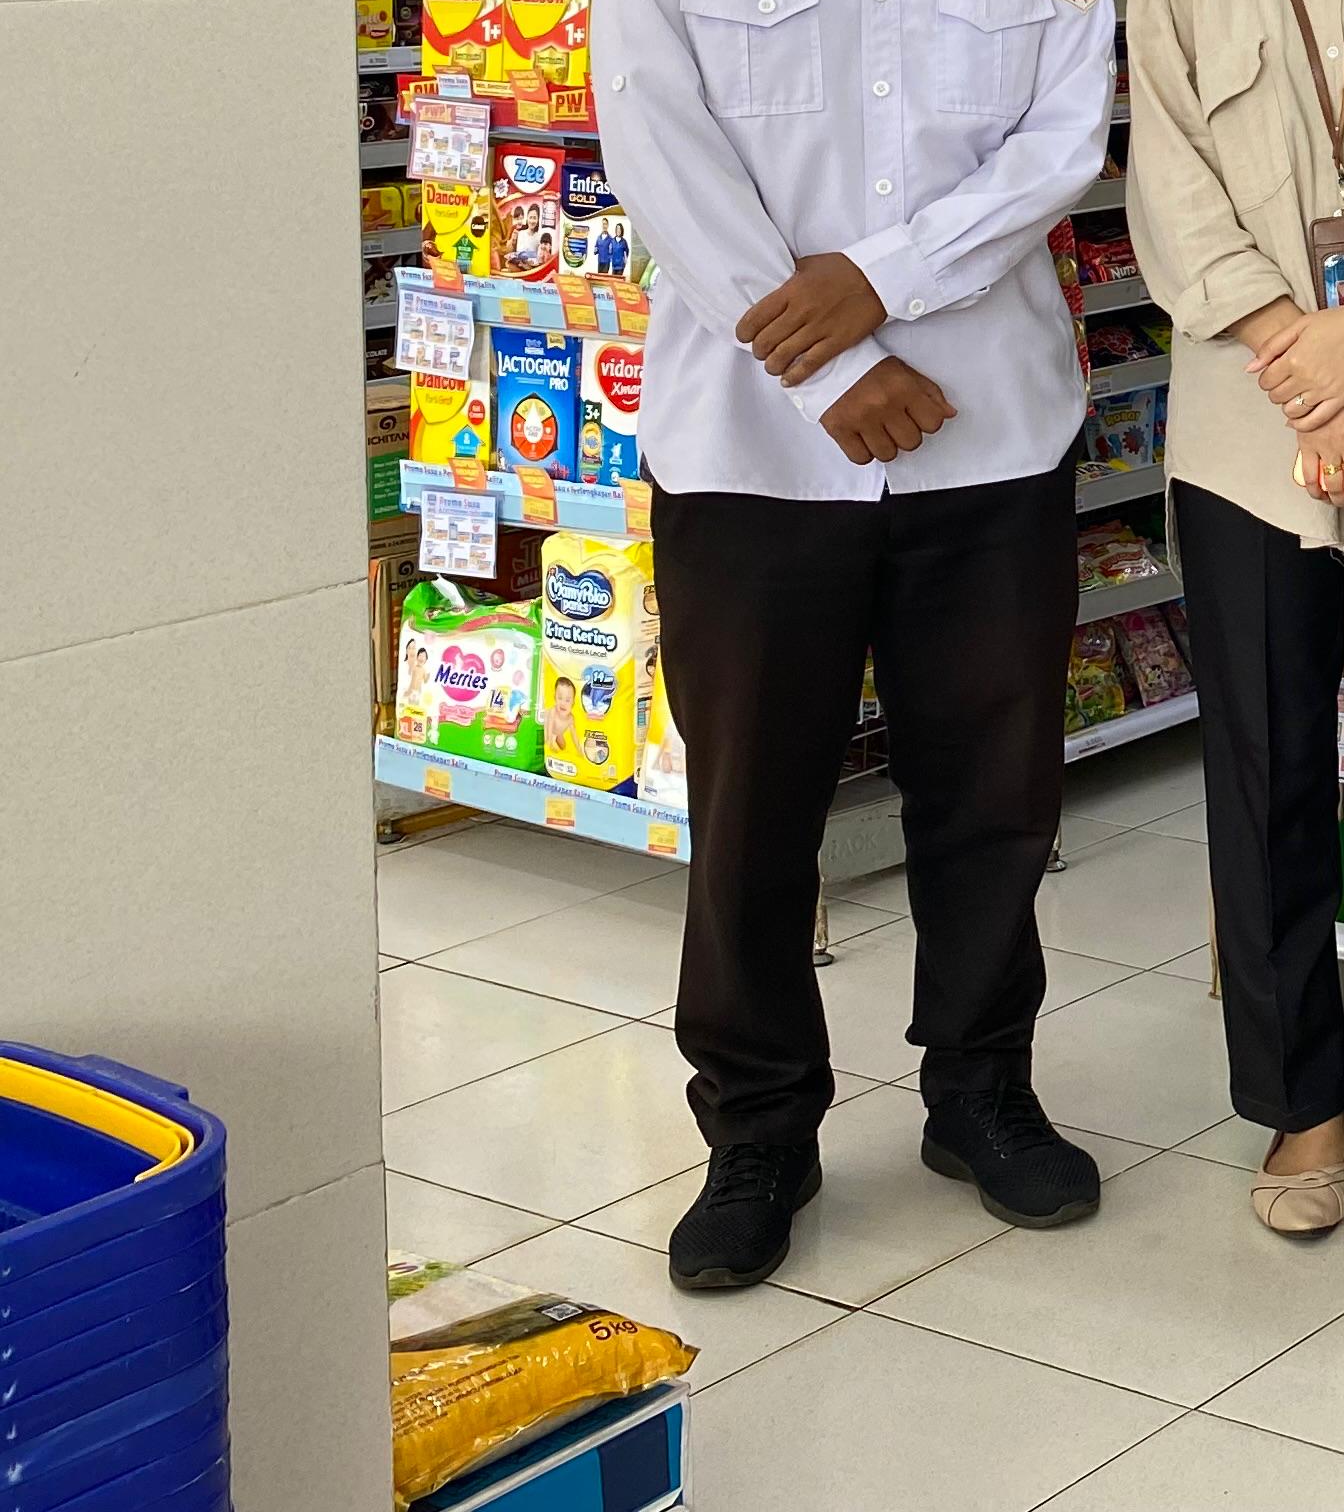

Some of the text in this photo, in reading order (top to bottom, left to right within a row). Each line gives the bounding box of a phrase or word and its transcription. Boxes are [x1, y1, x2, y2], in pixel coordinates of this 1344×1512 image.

[514, 158, 545, 184] Zee
[569, 193, 596, 203] GOLD
[498, 351, 571, 377] LACTOGROW
[549, 377, 568, 391] PRO
[572, 625, 617, 650] Kering
[434, 668, 488, 690] Merries
